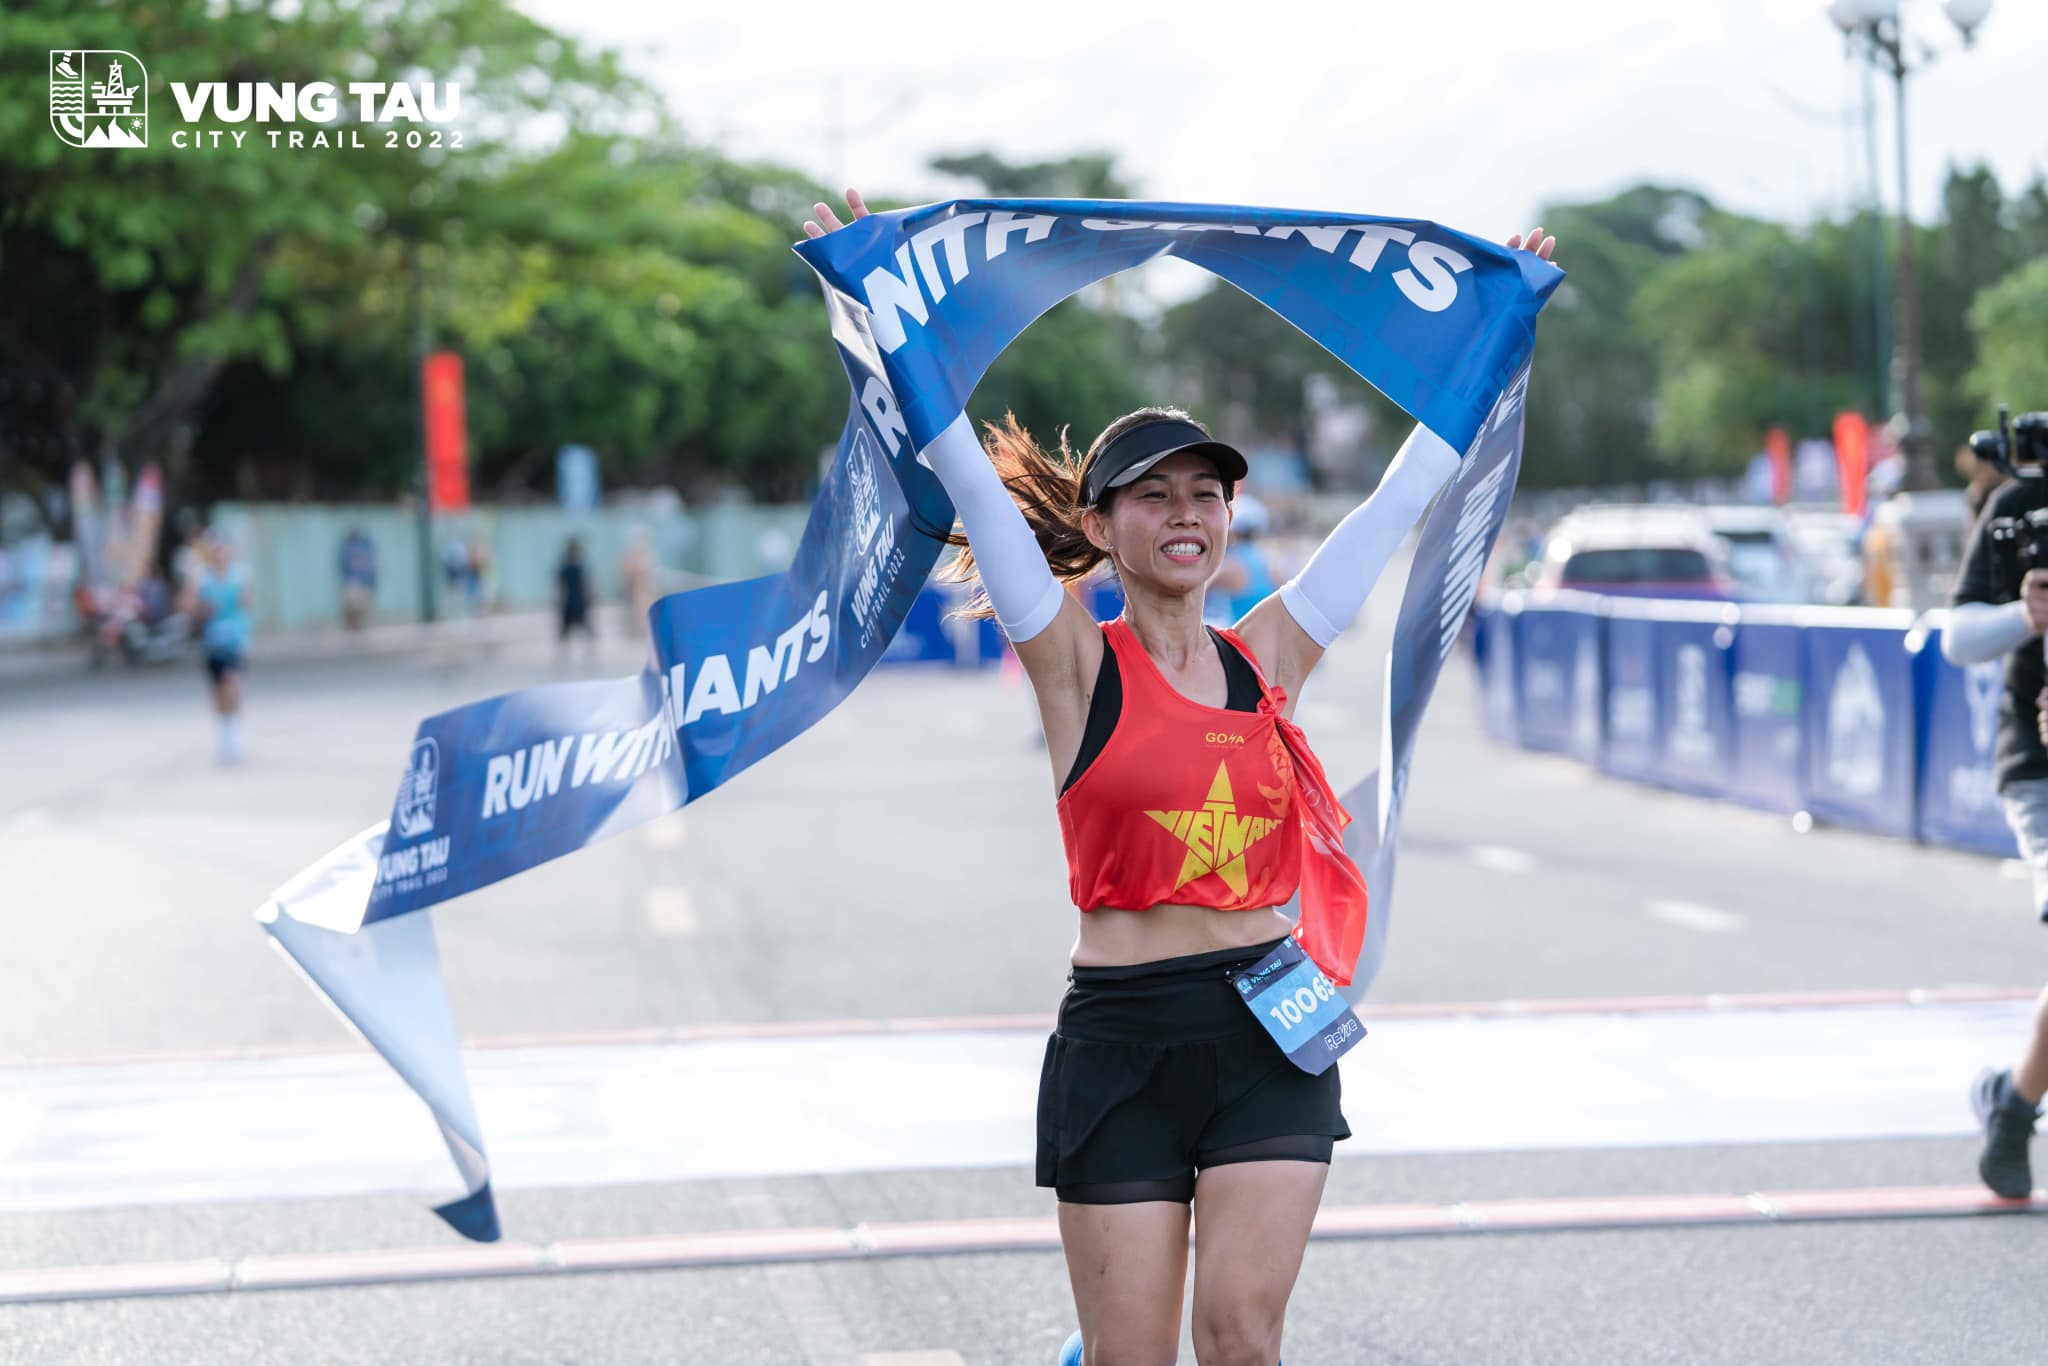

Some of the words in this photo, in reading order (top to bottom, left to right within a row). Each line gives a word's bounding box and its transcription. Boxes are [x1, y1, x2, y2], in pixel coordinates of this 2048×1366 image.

[850, 555, 879, 628] VUNG
[875, 512, 895, 573] TAU
[860, 616, 876, 649] CITY
[872, 581, 891, 620] TRAIL
[887, 546, 905, 583] 2022
[481, 735, 575, 819] RUN
[661, 589, 831, 731] IANTS
[420, 834, 451, 872] TAU
[1143, 800, 1283, 870] VIETNAM
[1269, 970, 1336, 1031] 10065
